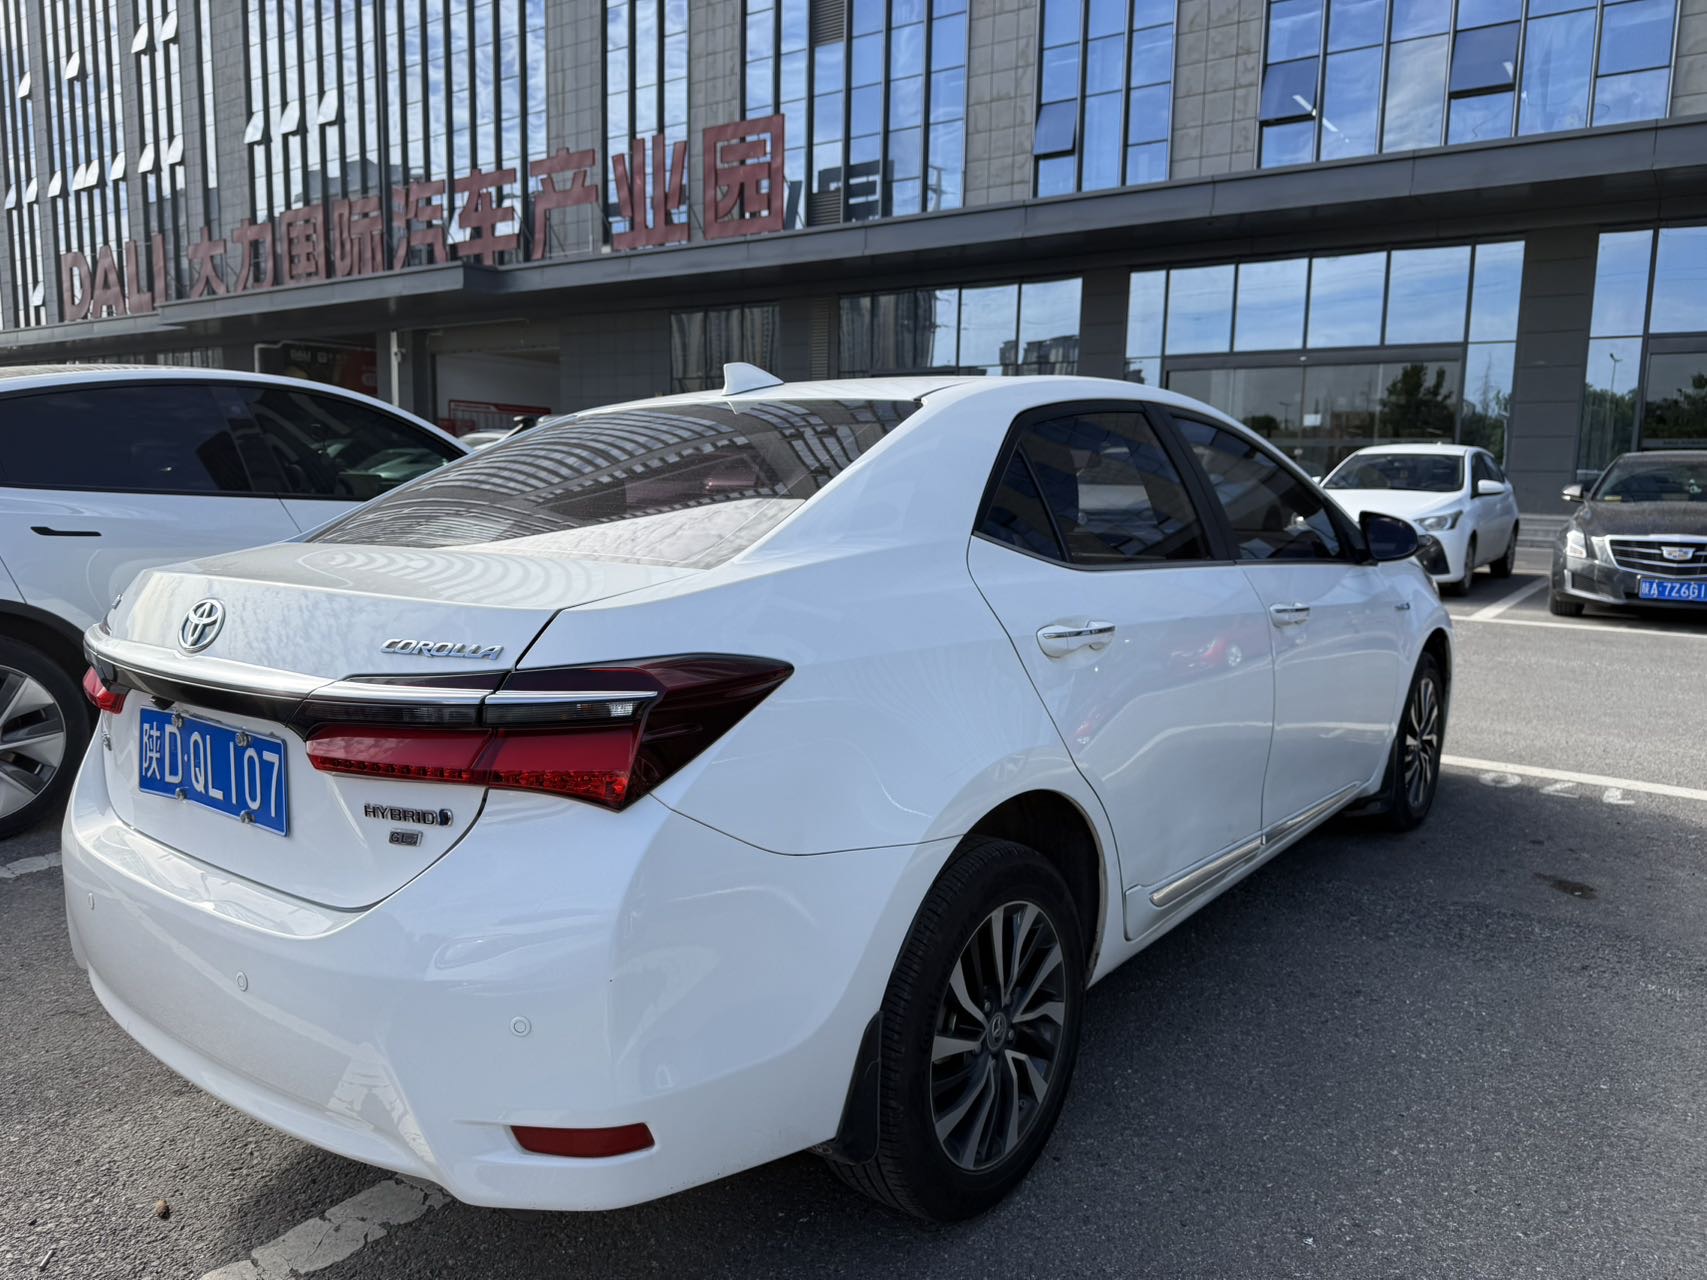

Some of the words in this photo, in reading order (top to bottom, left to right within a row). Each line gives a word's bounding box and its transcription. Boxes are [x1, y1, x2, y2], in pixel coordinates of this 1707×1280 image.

[60, 232, 167, 322] DALI
[188, 113, 786, 299] 大力国际汽车产业园
[380, 638, 504, 661] COROLLA
[363, 802, 439, 826] HYBRID
